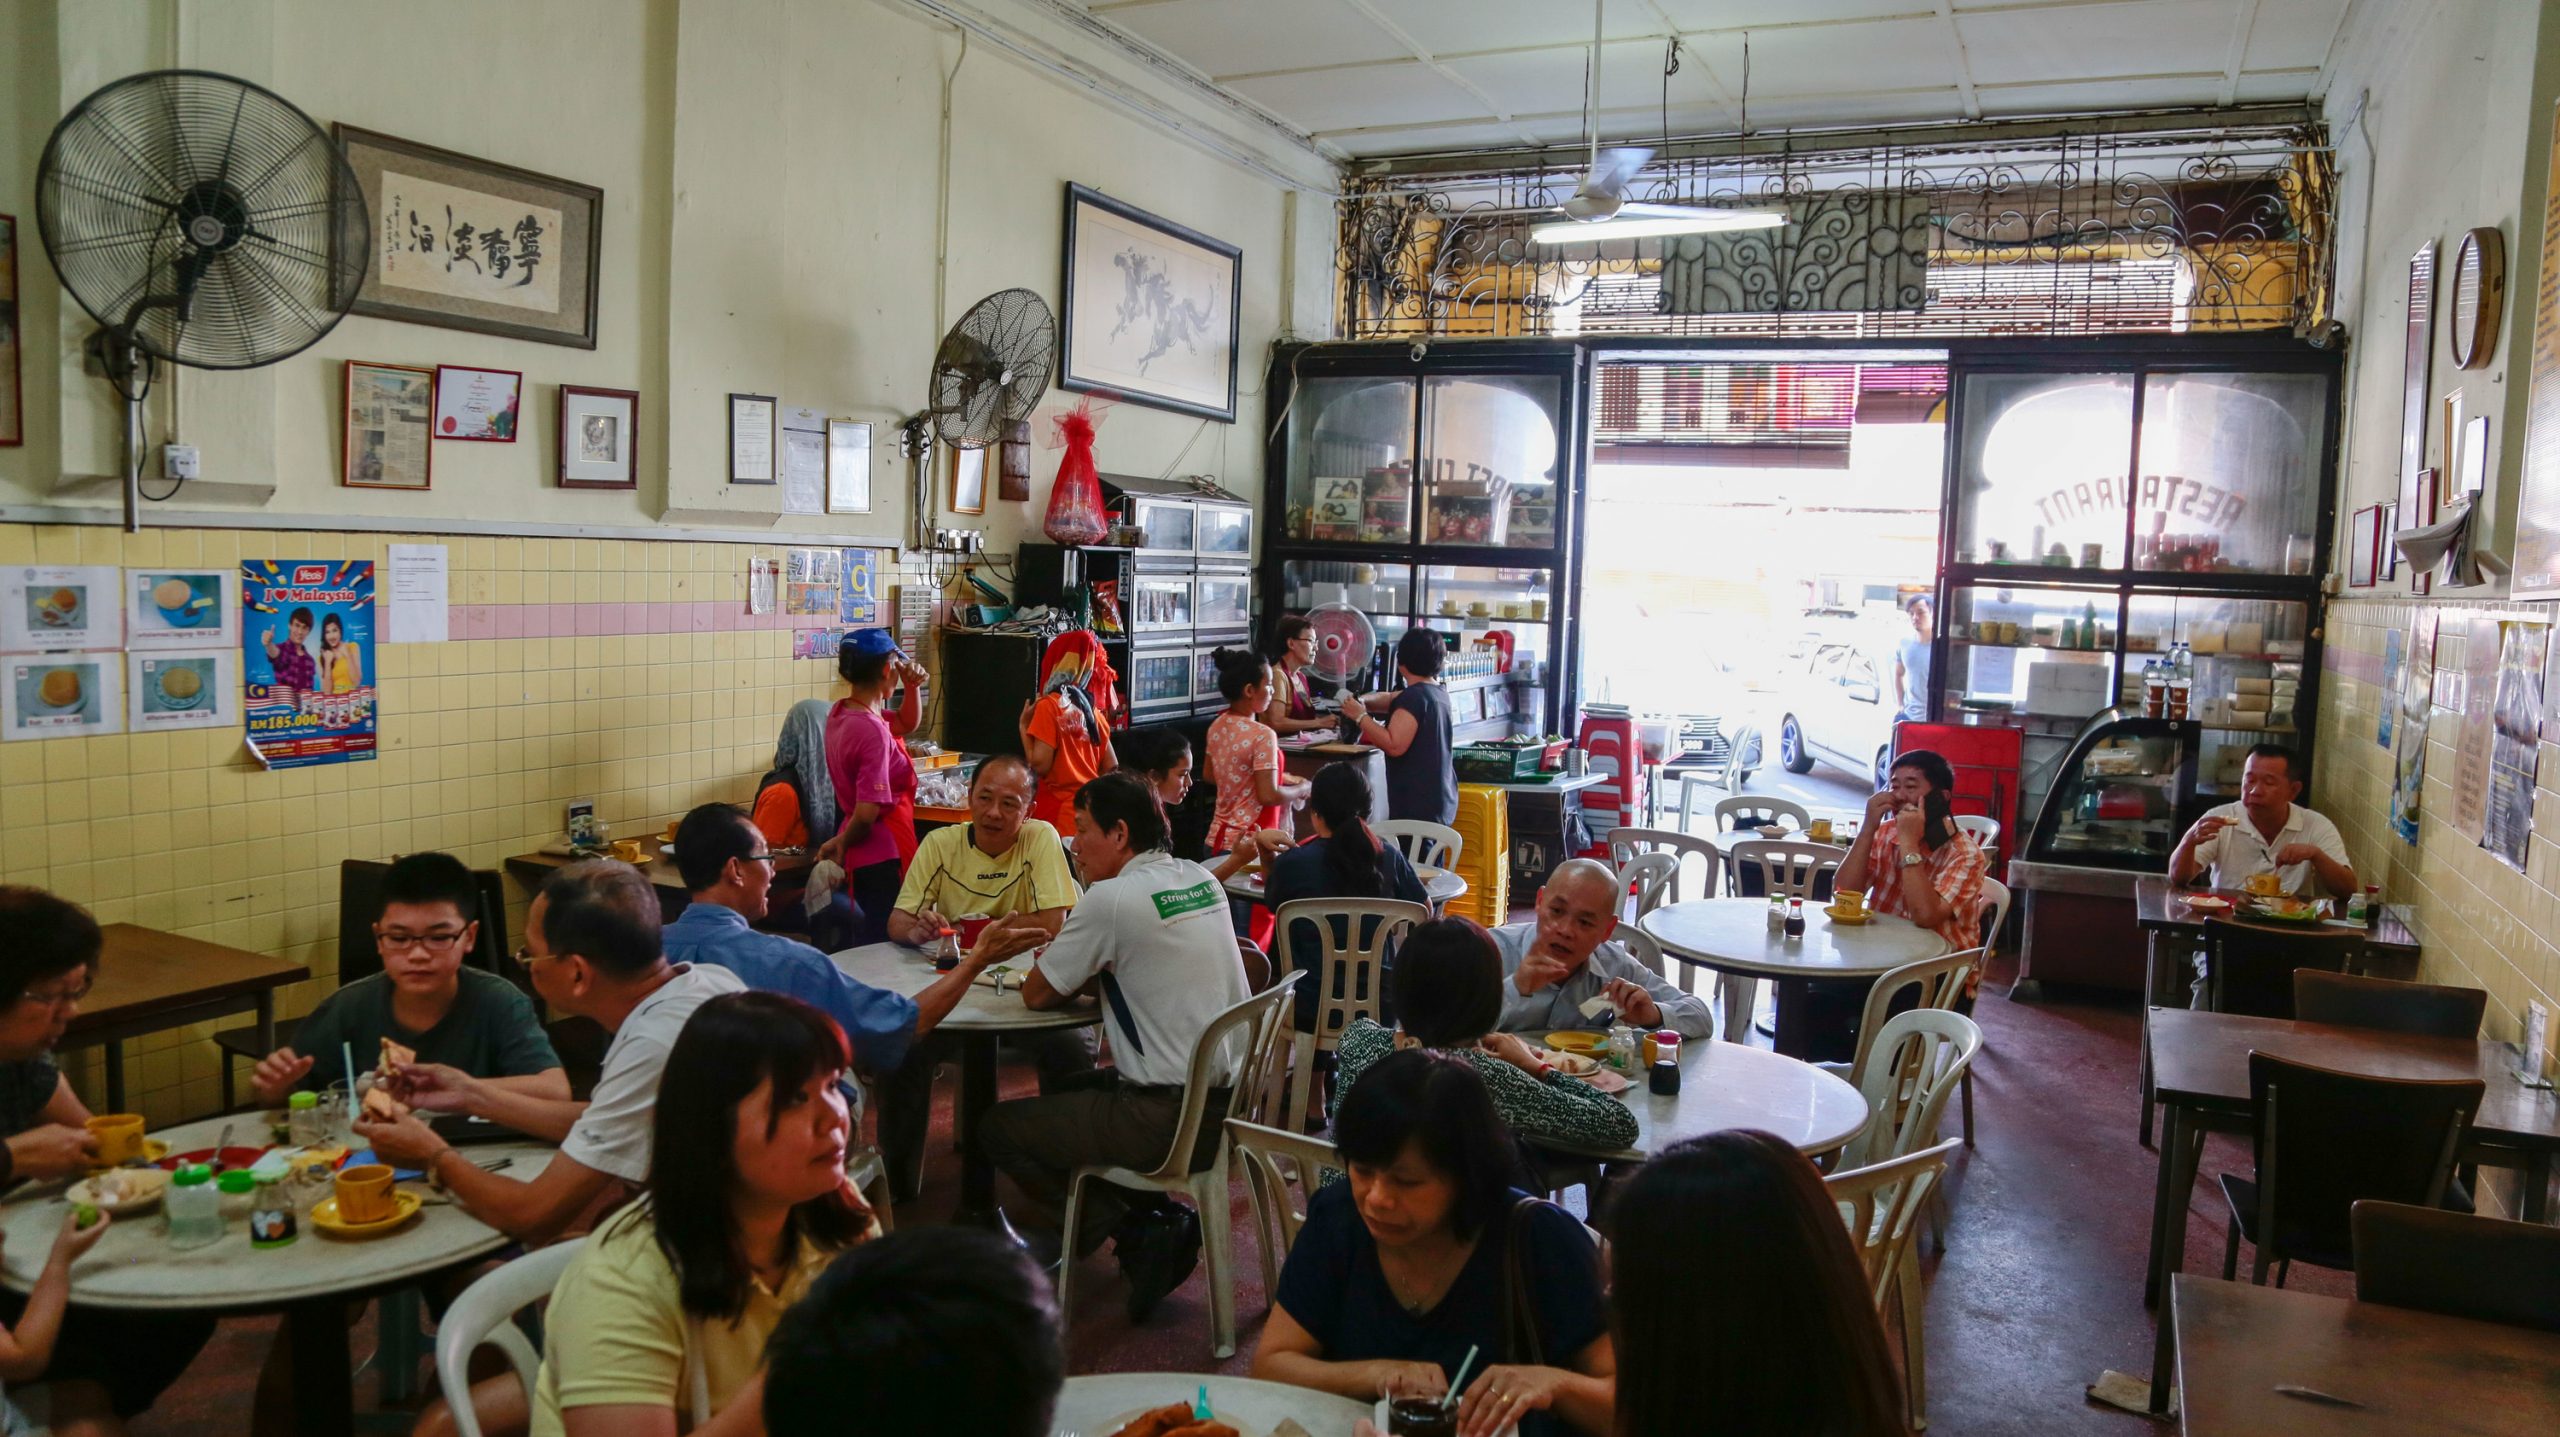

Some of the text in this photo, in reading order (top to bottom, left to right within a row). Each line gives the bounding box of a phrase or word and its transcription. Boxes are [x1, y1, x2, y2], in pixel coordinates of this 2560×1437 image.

[264, 587, 356, 604] I Malaysia
[811, 633, 841, 654] 2015
[1160, 893, 1188, 905] Strive
[1189, 889, 1204, 899] for
